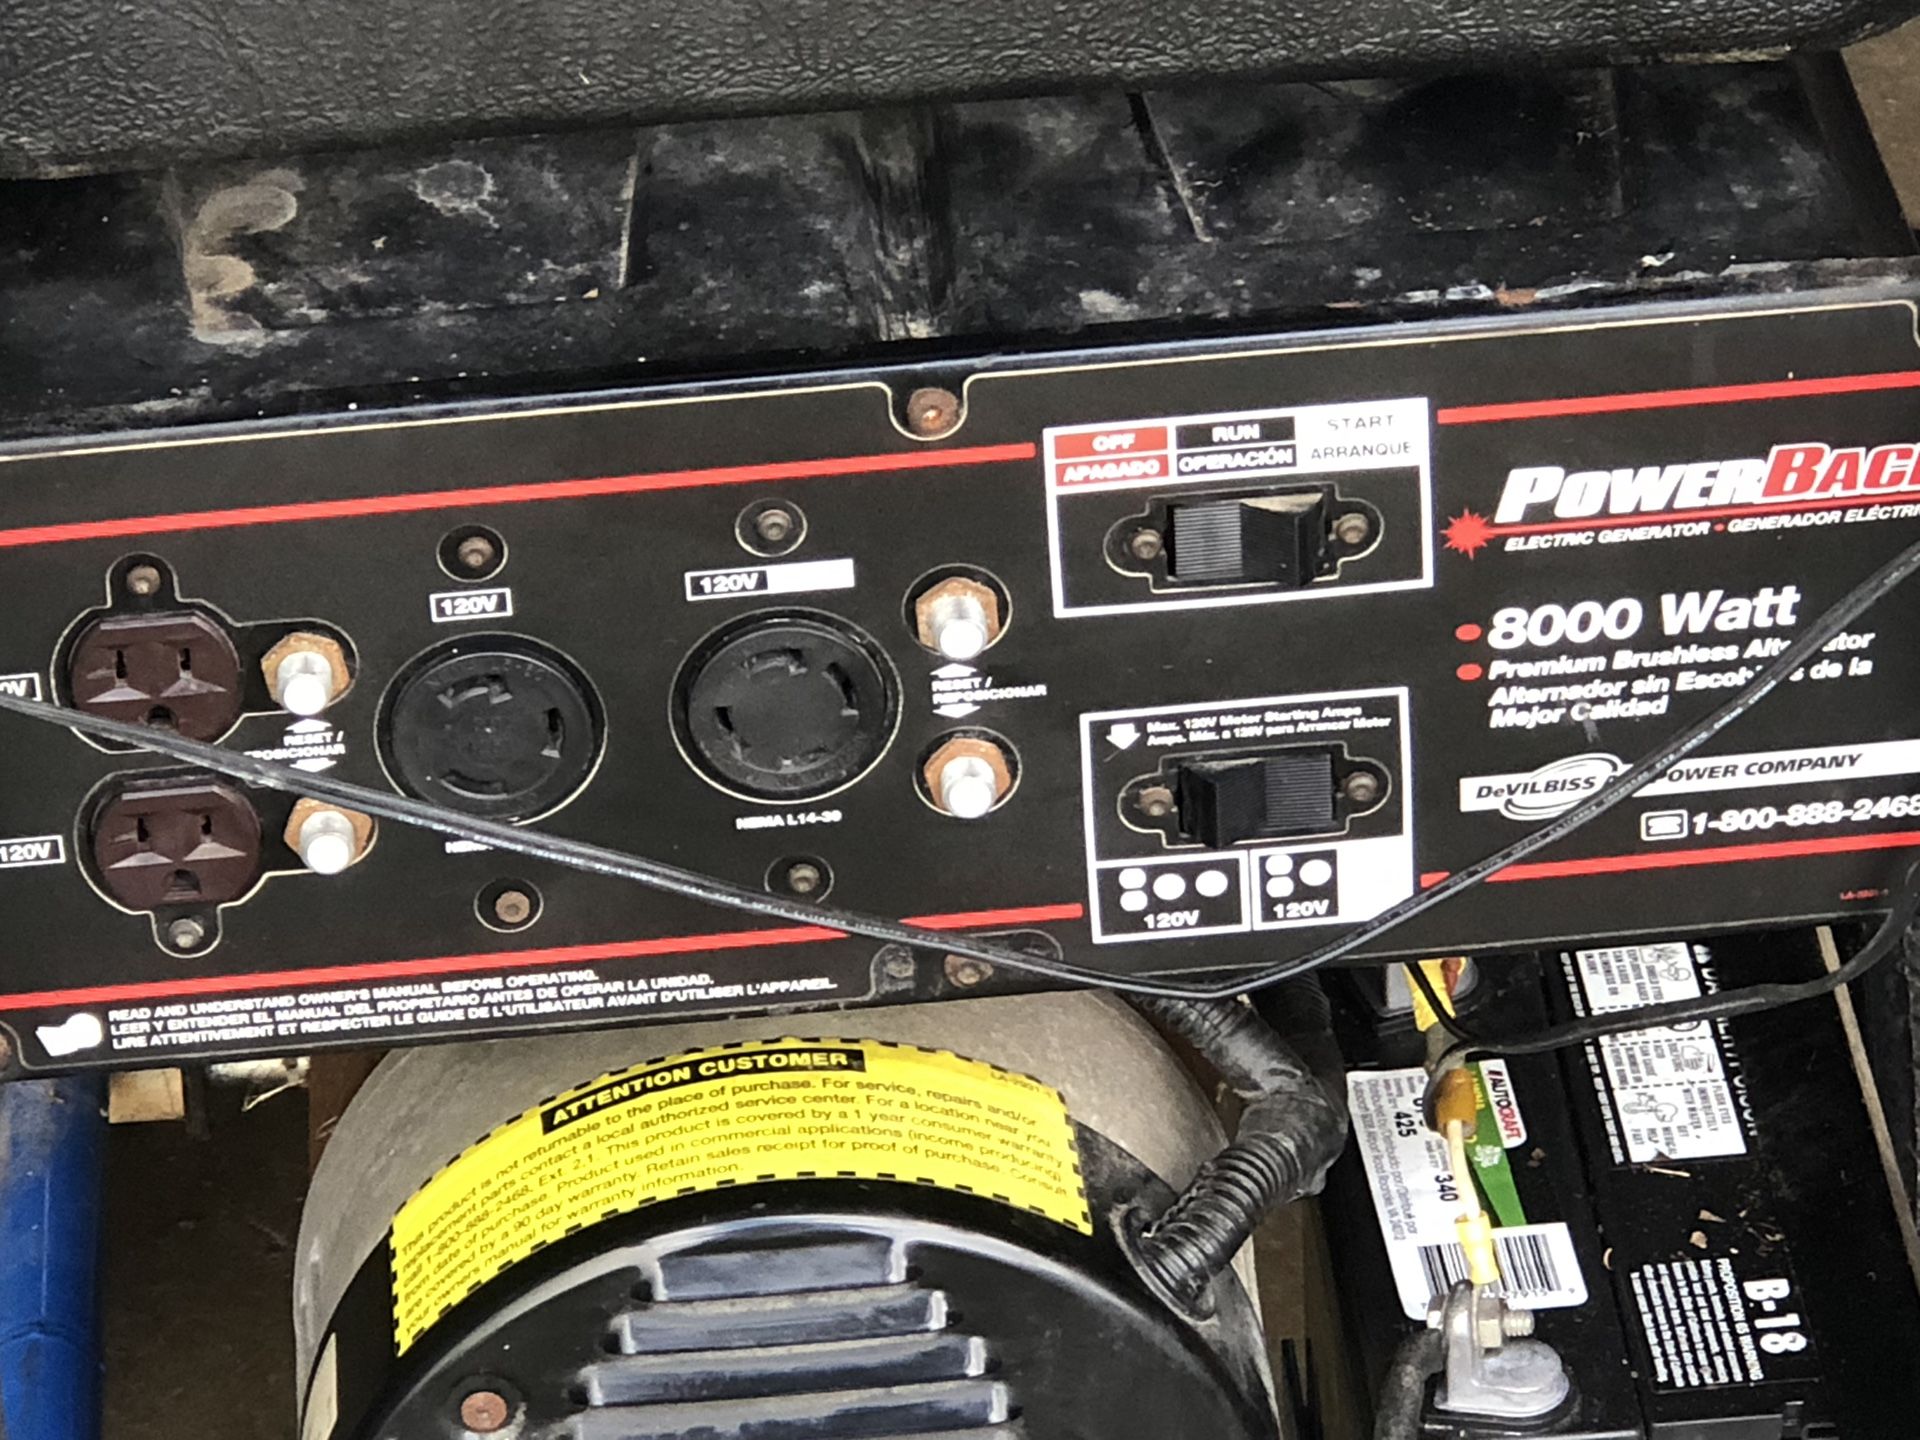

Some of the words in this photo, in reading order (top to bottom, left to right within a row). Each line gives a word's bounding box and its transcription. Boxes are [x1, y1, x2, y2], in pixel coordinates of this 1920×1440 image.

[1211, 423, 1261, 444] RUN
[1327, 414, 1394, 431] START
[1092, 433, 1136, 453] OFF
[1179, 446, 1294, 473] OPERACIÓN
[1310, 442, 1411, 460] ARRANQUE
[1063, 459, 1161, 483] APAGADO
[1494, 441, 1920, 524] POWERBAC
[1504, 530, 1595, 552] ELECTRIC
[1598, 522, 1711, 545] GENERATOR
[1727, 510, 1843, 534] GENERADOR
[699, 572, 759, 594] 120V
[441, 594, 497, 616] 120V
[1487, 597, 1644, 650] 8000
[1660, 585, 1802, 637] Watt
[1488, 655, 1608, 681] Premium
[1612, 643, 1741, 671] Brushless
[1488, 679, 1629, 708] Alternador
[1631, 674, 1671, 696] sin
[1809, 659, 1844, 680] de
[1848, 656, 1874, 677] la
[932, 677, 983, 692] RESET
[932, 684, 1047, 705] REPOSICIONAR
[1264, 709, 1320, 723] Starting
[1321, 706, 1363, 719] Amps
[1489, 705, 1568, 730] Mejor
[1570, 693, 1671, 721] Calidad
[283, 731, 334, 747] RESET
[1476, 776, 1598, 799] DeVILBISS
[1656, 763, 1739, 784] OWER
[1743, 753, 1863, 776] COMPANY
[1692, 793, 1920, 835] 1-800-888-2468
[0, 841, 51, 863] 120V
[1143, 909, 1201, 930] 120V
[1272, 899, 1330, 920] 120V
[108, 1007, 152, 1022] READ
[153, 1004, 189, 1019] AND
[189, 995, 297, 1016] UNDERSTAND
[297, 988, 372, 1007] OWNER'S
[372, 983, 441, 1000] MANUAL
[441, 977, 505, 994] BEFORE
[506, 969, 600, 989] OPERATING.
[110, 1020, 152, 1036] LEER
[152, 1019, 166, 1032] Y
[166, 1013, 250, 1031] ENTENDER
[251, 1011, 274, 1024] EL
[274, 1005, 342, 1023] MANUAL
[343, 1003, 376, 1017] DEL
[377, 993, 481, 1013] PROPIETARIO
[482, 988, 535, 1005] ANTES
[536, 986, 560, 1000] DE
[560, 980, 626, 998] OPERAR
[627, 978, 650, 992] LA
[650, 973, 715, 990] UNIDAD.
[112, 1035, 149, 1051] LIRE
[150, 1023, 277, 1047] ATTENTIVEMENT
[277, 1022, 299, 1036] ET
[299, 1014, 393, 1034] RESPECTER
[394, 1012, 415, 1026] LE
[416, 1007, 467, 1024] GUIDE
[467, 1005, 491, 1020] DE
[491, 997, 606, 1019] L'UTILISATEUR
[606, 992, 659, 1009] AVANT
[659, 984, 746, 1004] D'UTILISER
[553, 1066, 692, 1126] ATTENTION
[697, 1052, 849, 1077] CUSTOMER
[1489, 1077, 1522, 1140] AUTOCRAFT
[606, 1138, 640, 1156] This
[644, 1119, 711, 1146] product
[716, 1117, 731, 1128] is
[735, 1108, 806, 1125] covered
[811, 1108, 832, 1121] by
[838, 1110, 849, 1120] a
[853, 1108, 862, 1119] 1
[869, 1111, 905, 1123] year
[911, 1116, 992, 1140] consumer
[1393, 1111, 1418, 1138] 425
[427, 1187, 477, 1235] product
[480, 1179, 492, 1193] is
[496, 1160, 519, 1180] not
[522, 1122, 602, 1164] returnable
[606, 1114, 623, 1126] to
[626, 1103, 653, 1119] the
[657, 1092, 704, 1112] place
[708, 1085, 726, 1099] of
[731, 1080, 817, 1097] purchase.
[822, 1078, 851, 1089] For
[856, 1081, 921, 1098] service,
[926, 1090, 983, 1110] repairs
[481, 1180, 517, 1209] parts
[520, 1145, 578, 1181] contact
[581, 1140, 593, 1152] a
[596, 1122, 636, 1144] local
[640, 1100, 730, 1131] authorized
[735, 1094, 798, 1110] service
[866, 1094, 894, 1106] For
[899, 1100, 911, 1110] a
[914, 1100, 981, 1124] location
[985, 1118, 1019, 1135] near
[1434, 1174, 1459, 1202] 340
[404, 1274, 431, 1303] from
[433, 1248, 461, 1275] date
[464, 1233, 478, 1250] of
[557, 1160, 620, 1193] Product
[624, 1145, 665, 1166] used
[669, 1141, 686, 1153] in
[690, 1125, 793, 1149] commercial
[798, 1123, 904, 1137] applications
[907, 1130, 975, 1152] (income
[425, 1251, 476, 1298] covered
[480, 1238, 498, 1254] by
[513, 1215, 532, 1233] 90
[535, 1201, 564, 1221] day
[645, 1154, 702, 1175] Retain
[706, 1146, 752, 1160] sales
[756, 1138, 817, 1153] receipt
[821, 1138, 847, 1150] for
[851, 1141, 897, 1152] proof
[901, 1144, 919, 1155] of
[485, 1228, 537, 1268] manual
[540, 1216, 561, 1234] for
[566, 1187, 637, 1220] warranty
[641, 1161, 745, 1191] information.
[1716, 1257, 1746, 1322] PROPOSITION
[1734, 1322, 1750, 1335] 65
[1742, 1277, 1808, 1355] B-18
